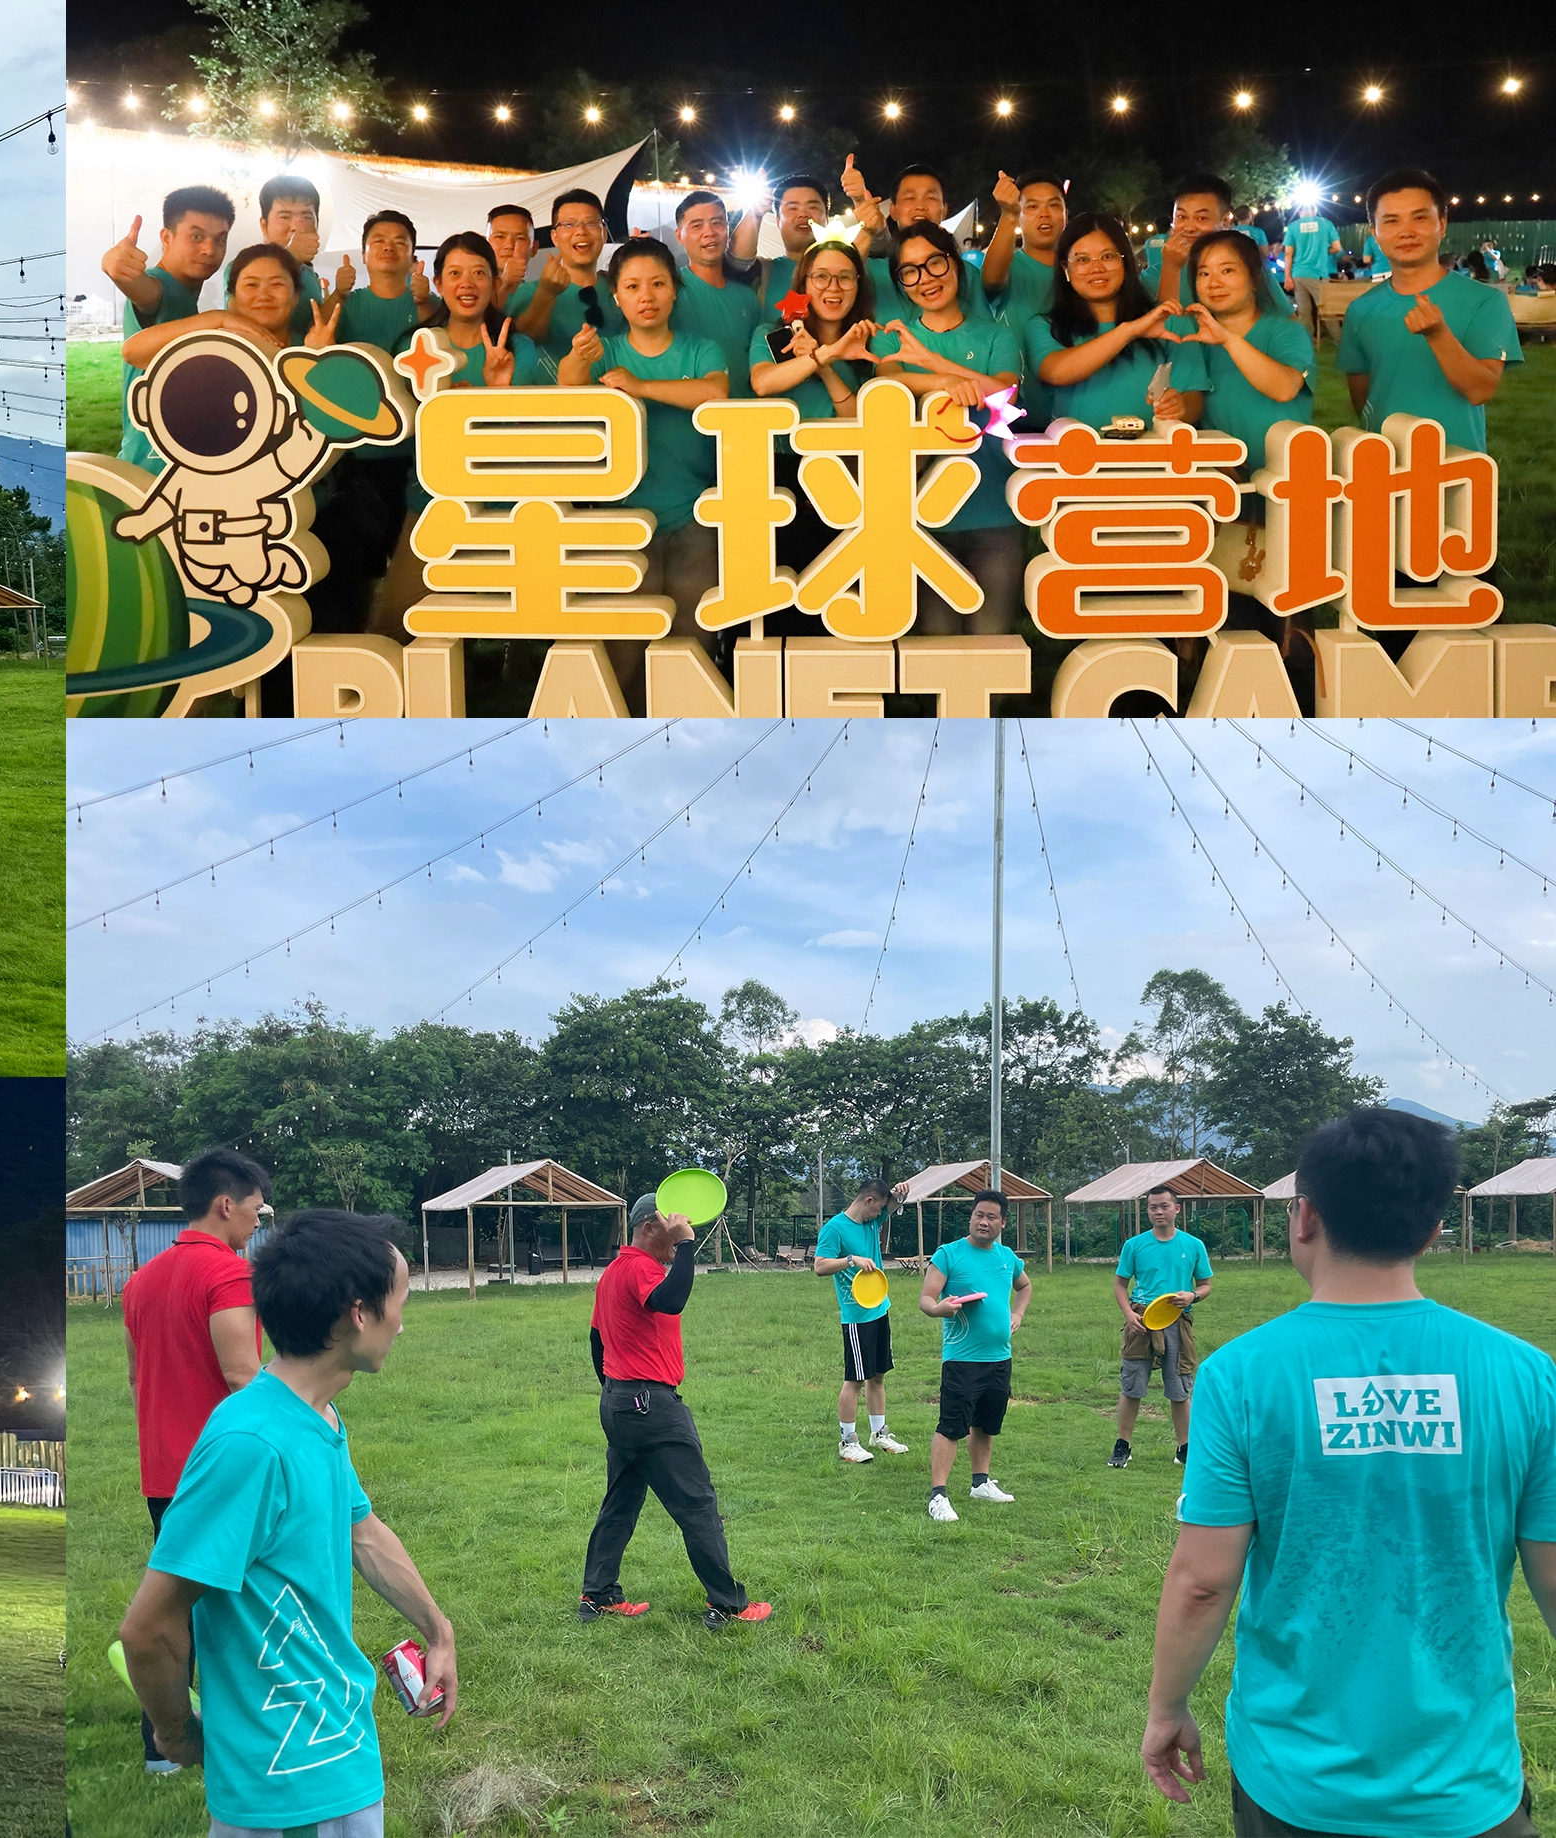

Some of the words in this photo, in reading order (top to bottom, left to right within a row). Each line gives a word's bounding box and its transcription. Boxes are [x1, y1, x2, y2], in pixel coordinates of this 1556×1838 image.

[402, 377, 1505, 642] 星球营地
[1333, 1381, 1442, 1418] LOVE
[1326, 1420, 1456, 1449] ZINWI
